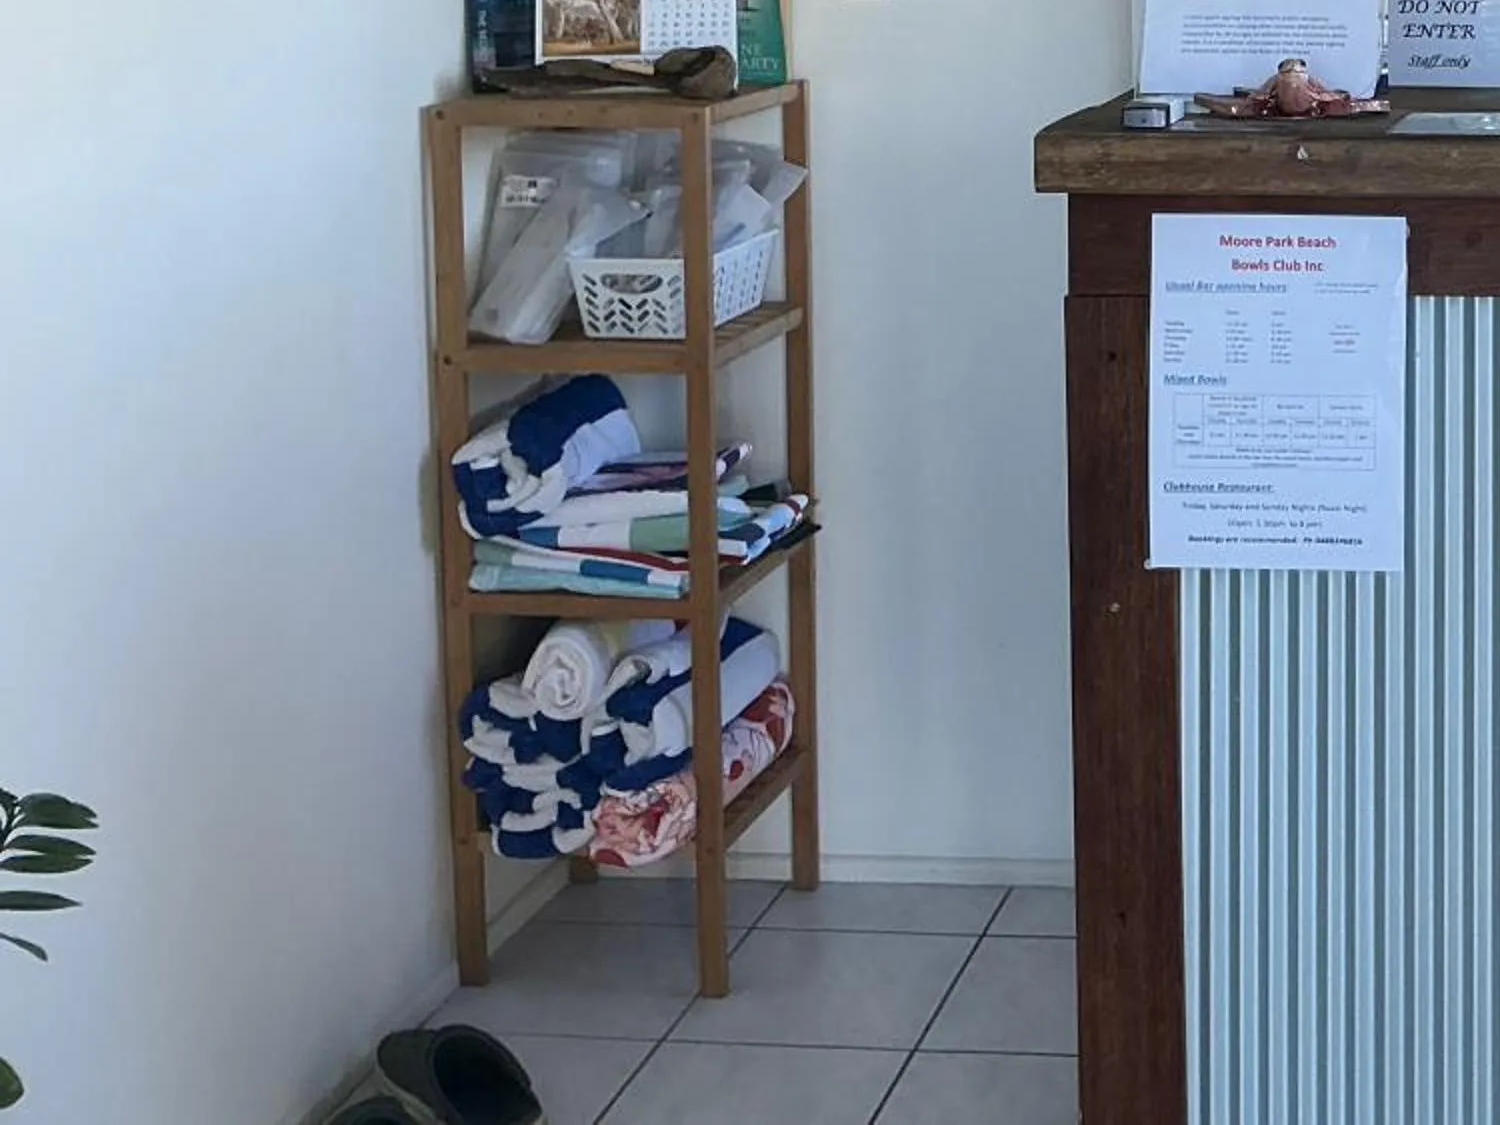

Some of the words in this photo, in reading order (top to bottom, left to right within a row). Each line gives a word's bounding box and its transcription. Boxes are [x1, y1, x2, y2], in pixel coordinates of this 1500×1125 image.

[1402, 22, 1477, 40] ENTER
[1407, 53, 1443, 70] Staff
[1441, 54, 1471, 70] only
[1218, 234, 1263, 249] Moore
[1265, 235, 1296, 249] Park
[1297, 236, 1337, 249] Beach
[1231, 258, 1270, 272] Bowls
[1273, 259, 1302, 272] Club
[1304, 260, 1323, 272] Inc
[1197, 280, 1215, 293] Bar
[1216, 282, 1257, 295] opening
[1258, 282, 1288, 294] hours
[1197, 375, 1227, 387] Bowls
[1163, 480, 1215, 493] Clubhouse
[1245, 503, 1260, 511] and
[1187, 534, 1223, 545] Bookings
[1225, 536, 1239, 544] are
[1240, 535, 1297, 545] recommended
